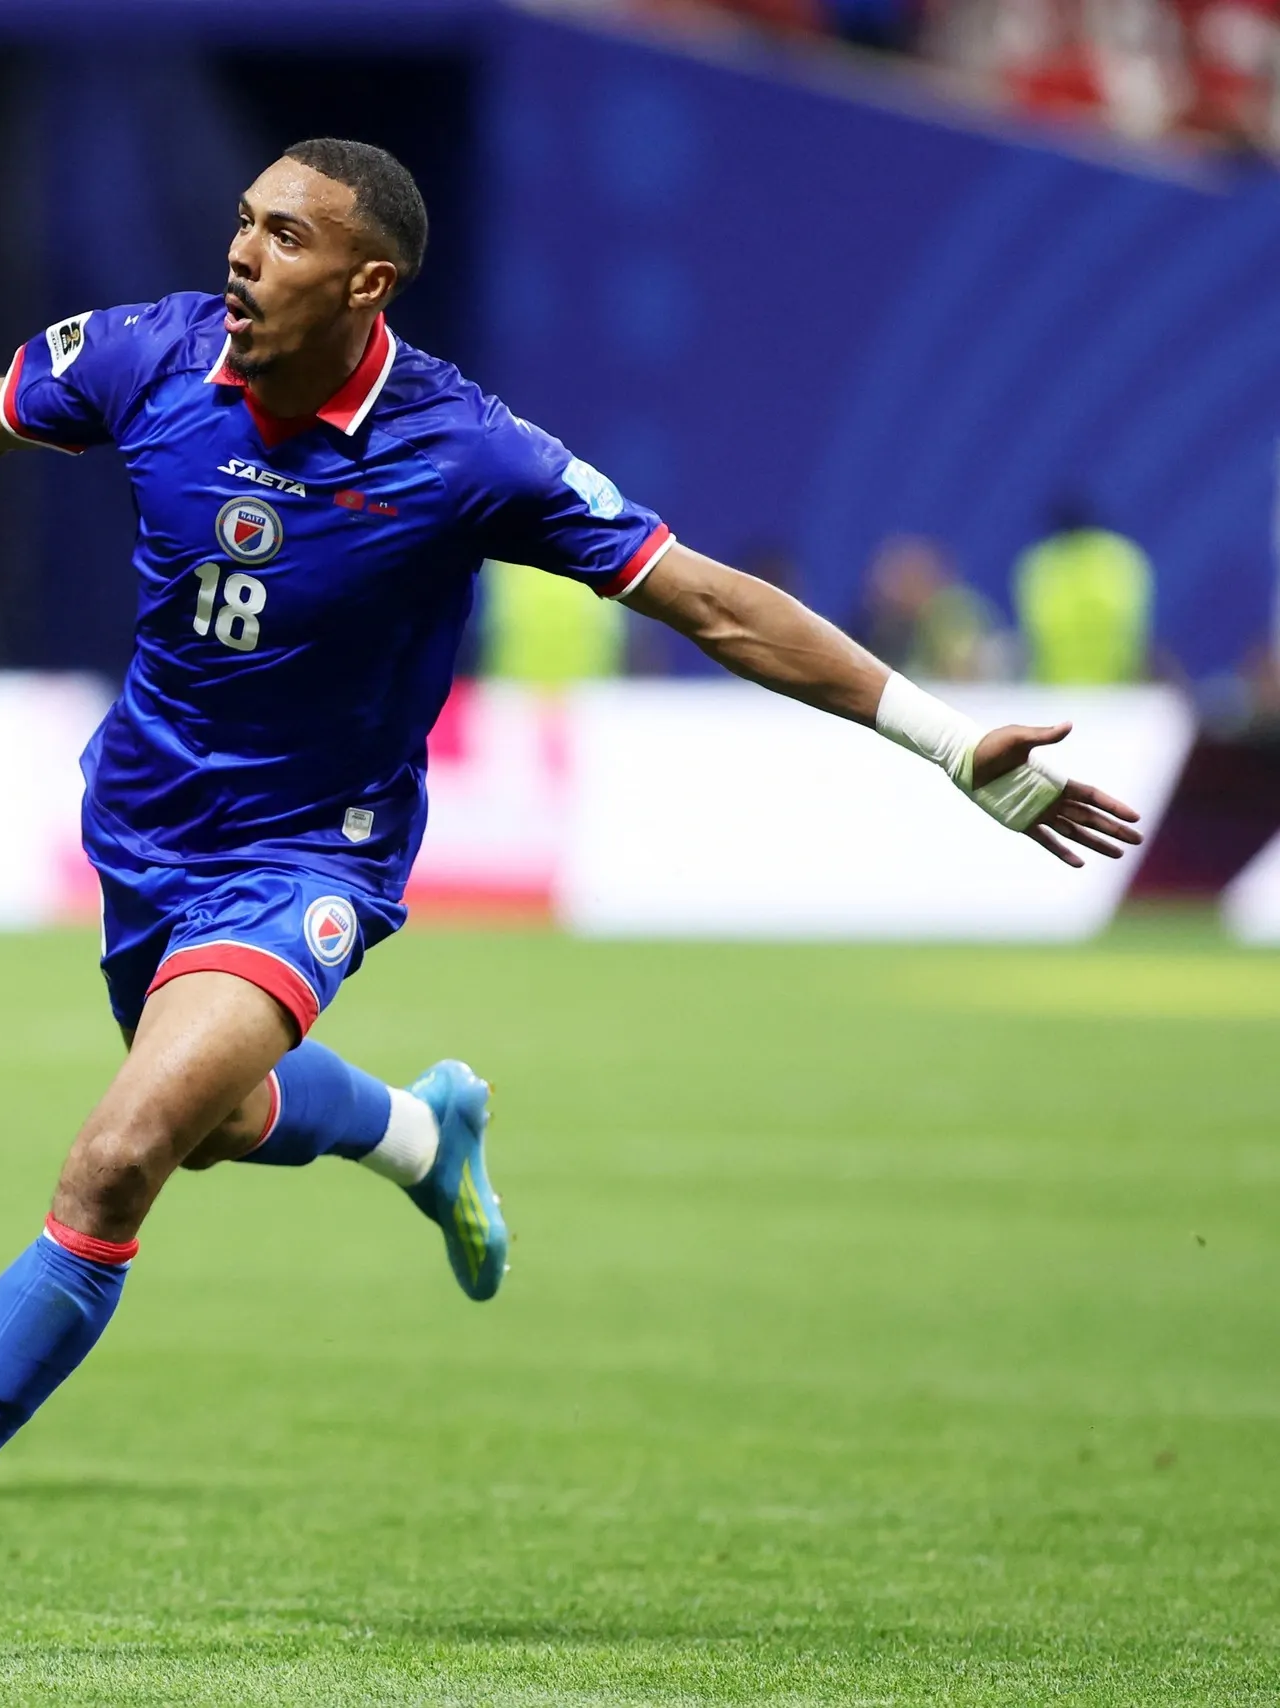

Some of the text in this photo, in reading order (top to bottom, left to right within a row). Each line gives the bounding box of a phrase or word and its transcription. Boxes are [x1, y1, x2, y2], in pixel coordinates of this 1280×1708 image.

[217, 459, 306, 498] SAETA
[240, 511, 264, 524] HAITI
[193, 562, 267, 651] 18
